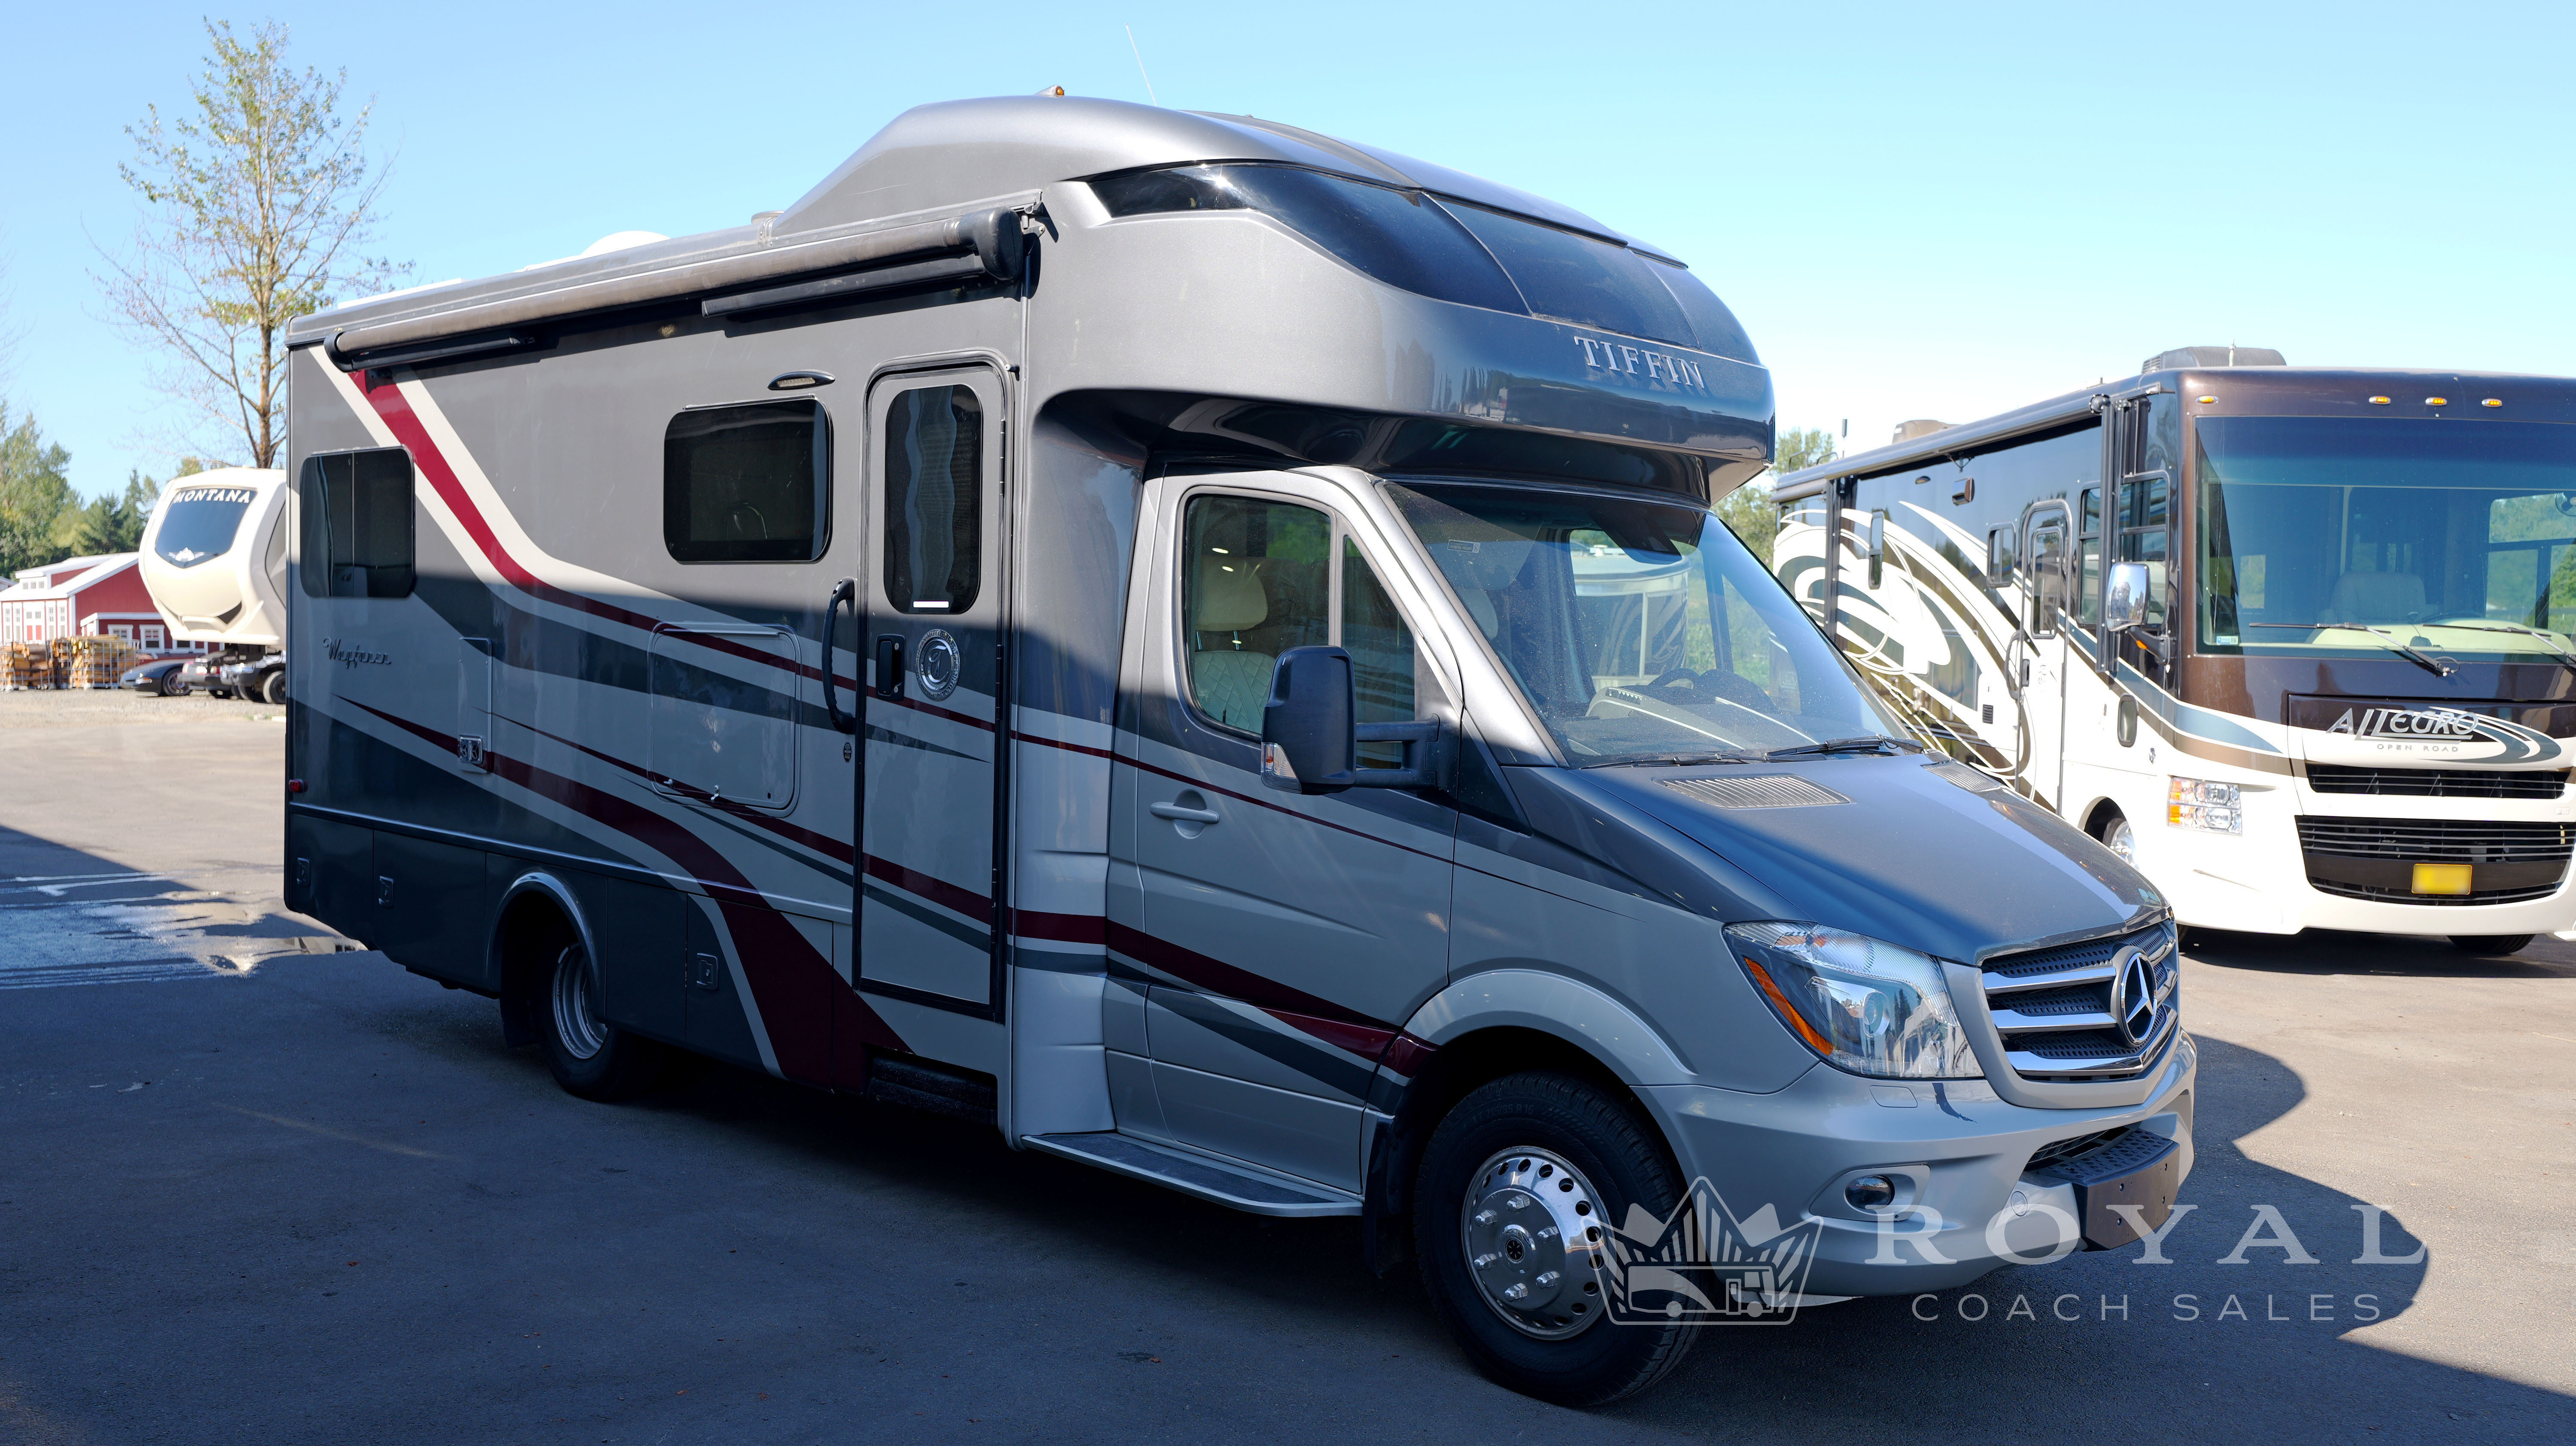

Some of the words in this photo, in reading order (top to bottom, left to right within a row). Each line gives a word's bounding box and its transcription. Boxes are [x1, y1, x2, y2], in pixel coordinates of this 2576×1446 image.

[1574, 336, 1704, 389] TIFFIN
[173, 489, 250, 504] MONTANA
[322, 636, 392, 669] Wayfarer
[2325, 707, 2479, 744] ALLEGRO
